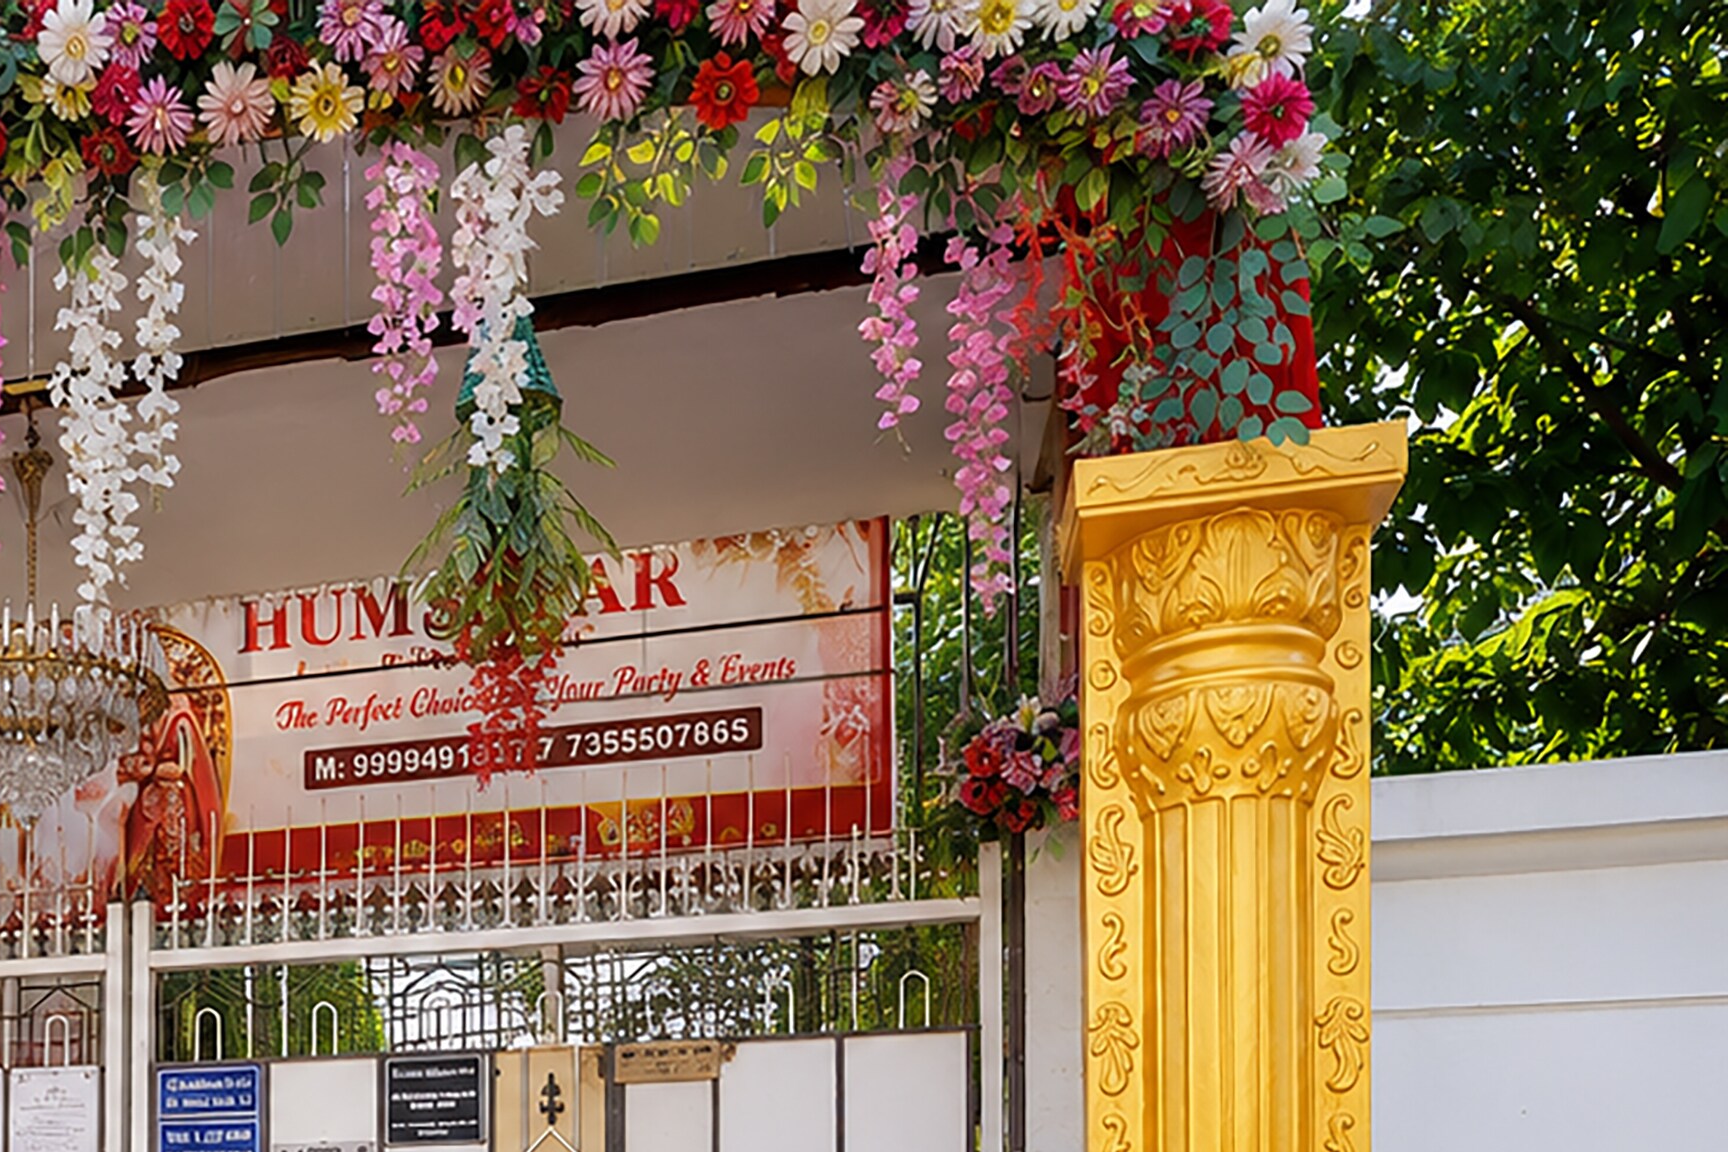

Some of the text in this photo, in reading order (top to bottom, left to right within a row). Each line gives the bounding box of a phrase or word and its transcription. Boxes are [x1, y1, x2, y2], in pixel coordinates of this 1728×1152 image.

[238, 551, 687, 654] HUMSAR
[275, 700, 318, 731] The
[326, 694, 403, 731] Perfect
[409, 686, 485, 719] Choic
[613, 665, 683, 702] Party
[690, 659, 710, 687] &
[719, 654, 796, 684] Events
[566, 717, 749, 758] 7355507865
